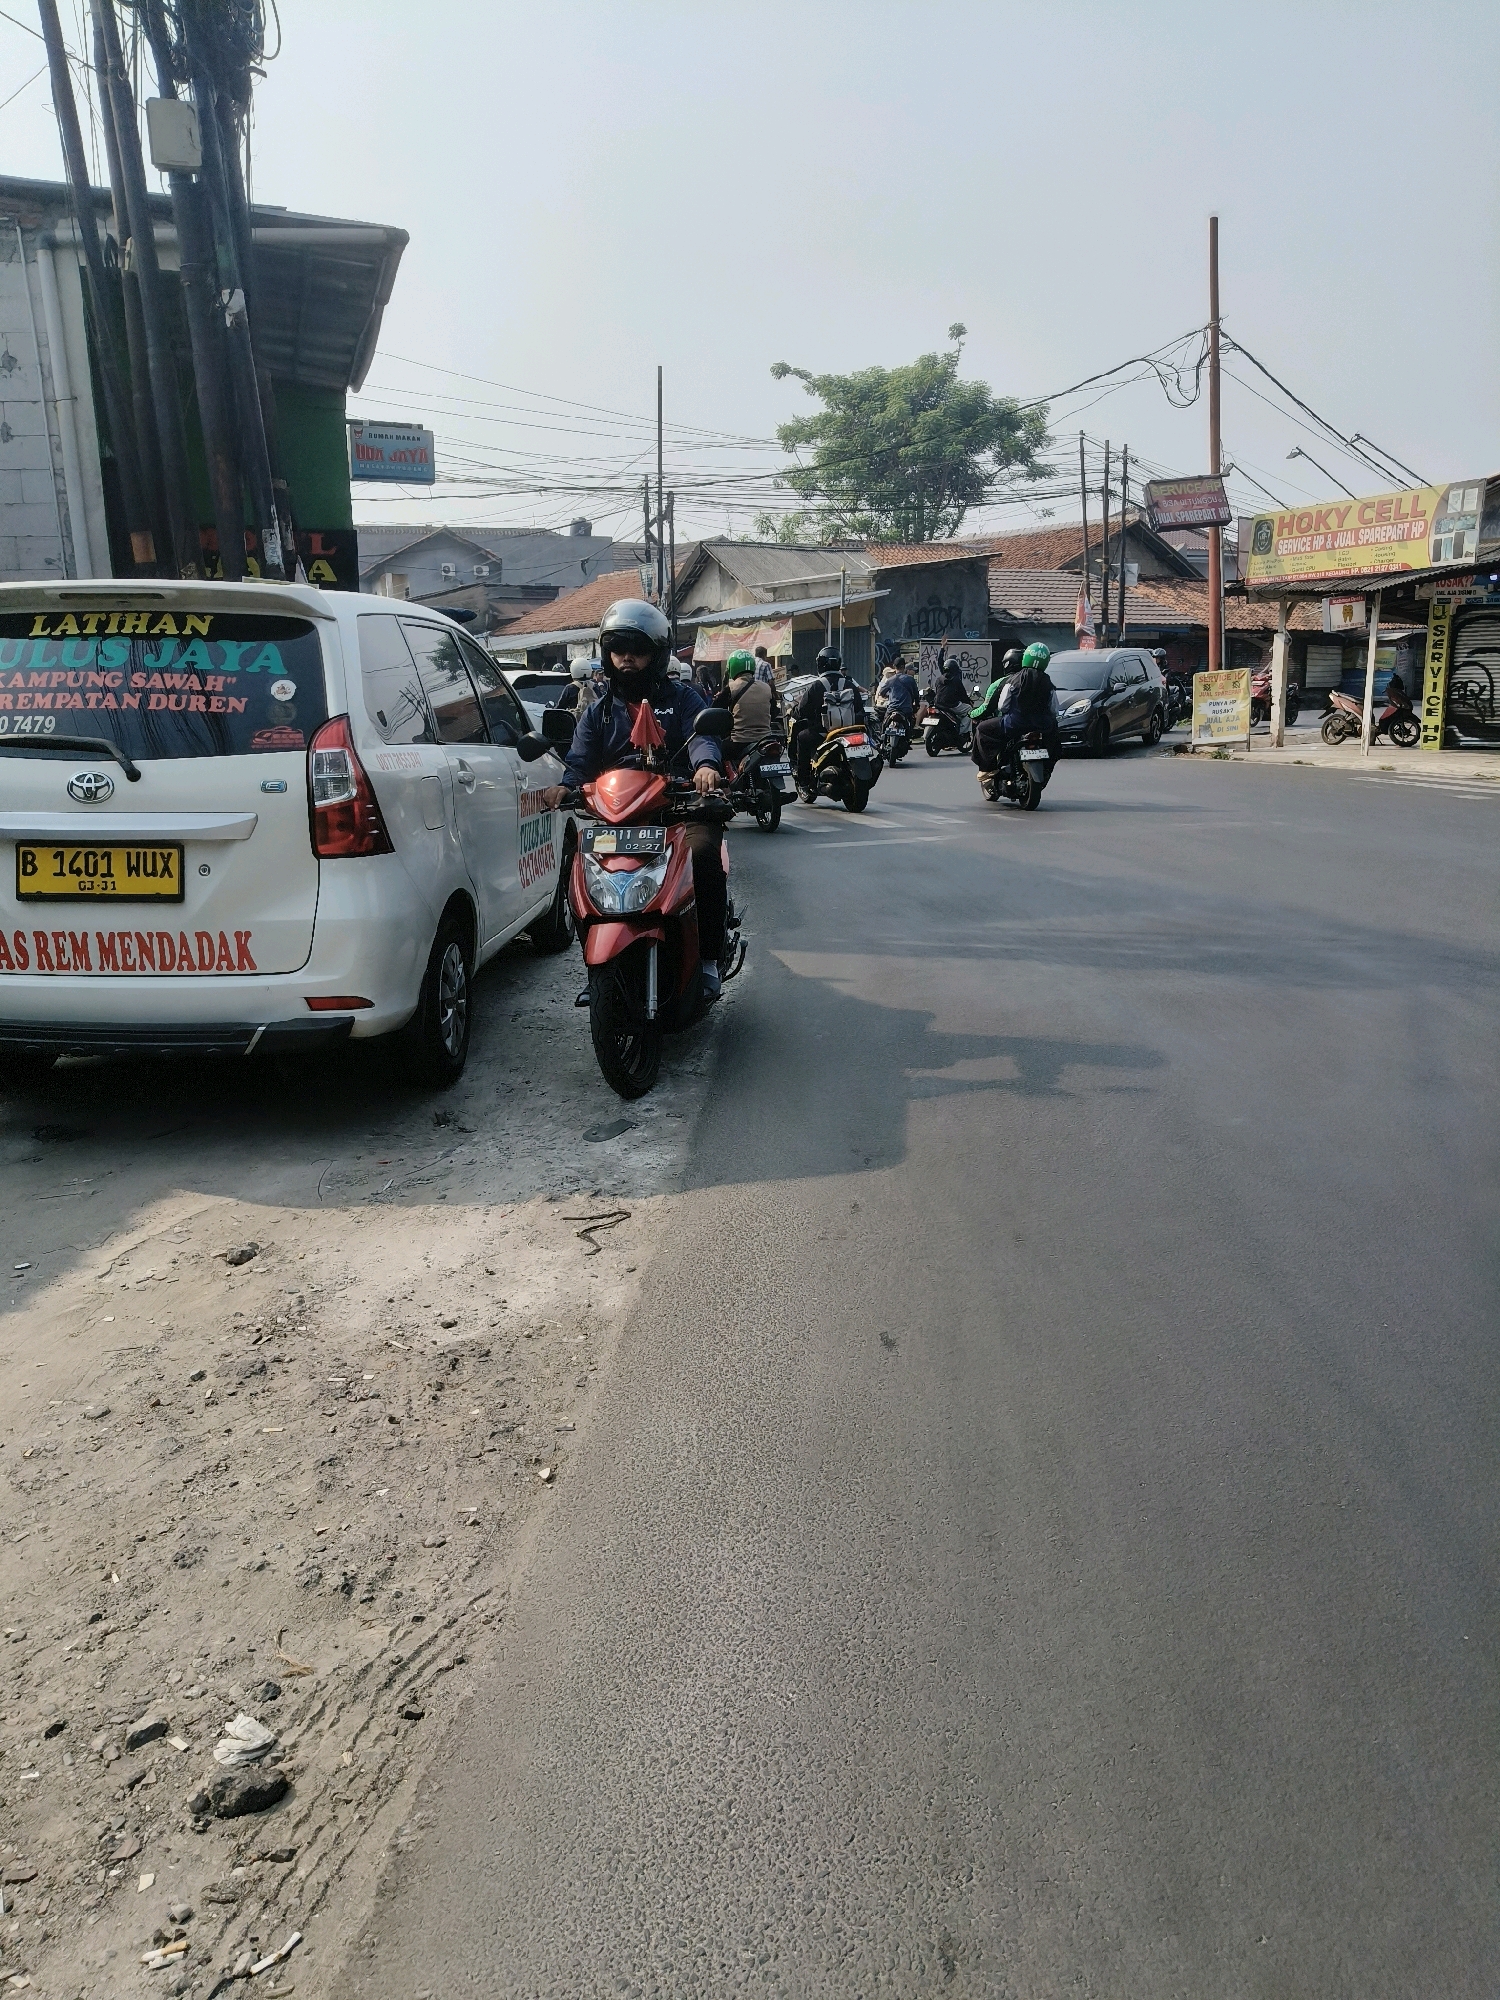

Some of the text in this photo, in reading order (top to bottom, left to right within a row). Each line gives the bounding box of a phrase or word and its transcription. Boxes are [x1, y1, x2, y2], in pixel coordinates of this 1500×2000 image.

[389, 447, 429, 464] JAYA
[1151, 481, 1221, 496] SERVICE HP
[1176, 508, 1217, 522] SPAREPART
[1218, 507, 1229, 519] HP
[1277, 495, 1426, 537] HOKY CELL
[1278, 537, 1312, 556] SERVICE
[1312, 536, 1325, 551] HP
[1325, 535, 1333, 550] &
[1333, 529, 1356, 549] JUAL
[1358, 523, 1410, 546] SPAREPART
[1410, 520, 1425, 538] HP
[29, 612, 215, 637] LATIHAN
[144, 638, 288, 675] JAYA
[1198, 673, 1232, 683] SERVICE
[1426, 624, 1446, 717] SERVICE
[130, 672, 237, 692] SAWAH"
[1214, 688, 1245, 697] SPAREPART
[0, 692, 248, 714] REMPATAN DUREN
[13, 715, 56, 734] 7479
[1205, 715, 1241, 724] JUAL AJA
[1422, 724, 1440, 744] HP
[586, 829, 594, 840] B
[625, 843, 661, 851] 02-27
[21, 849, 174, 879] B 1401 WUX
[0, 929, 258, 972] AS REM MENDADAK
